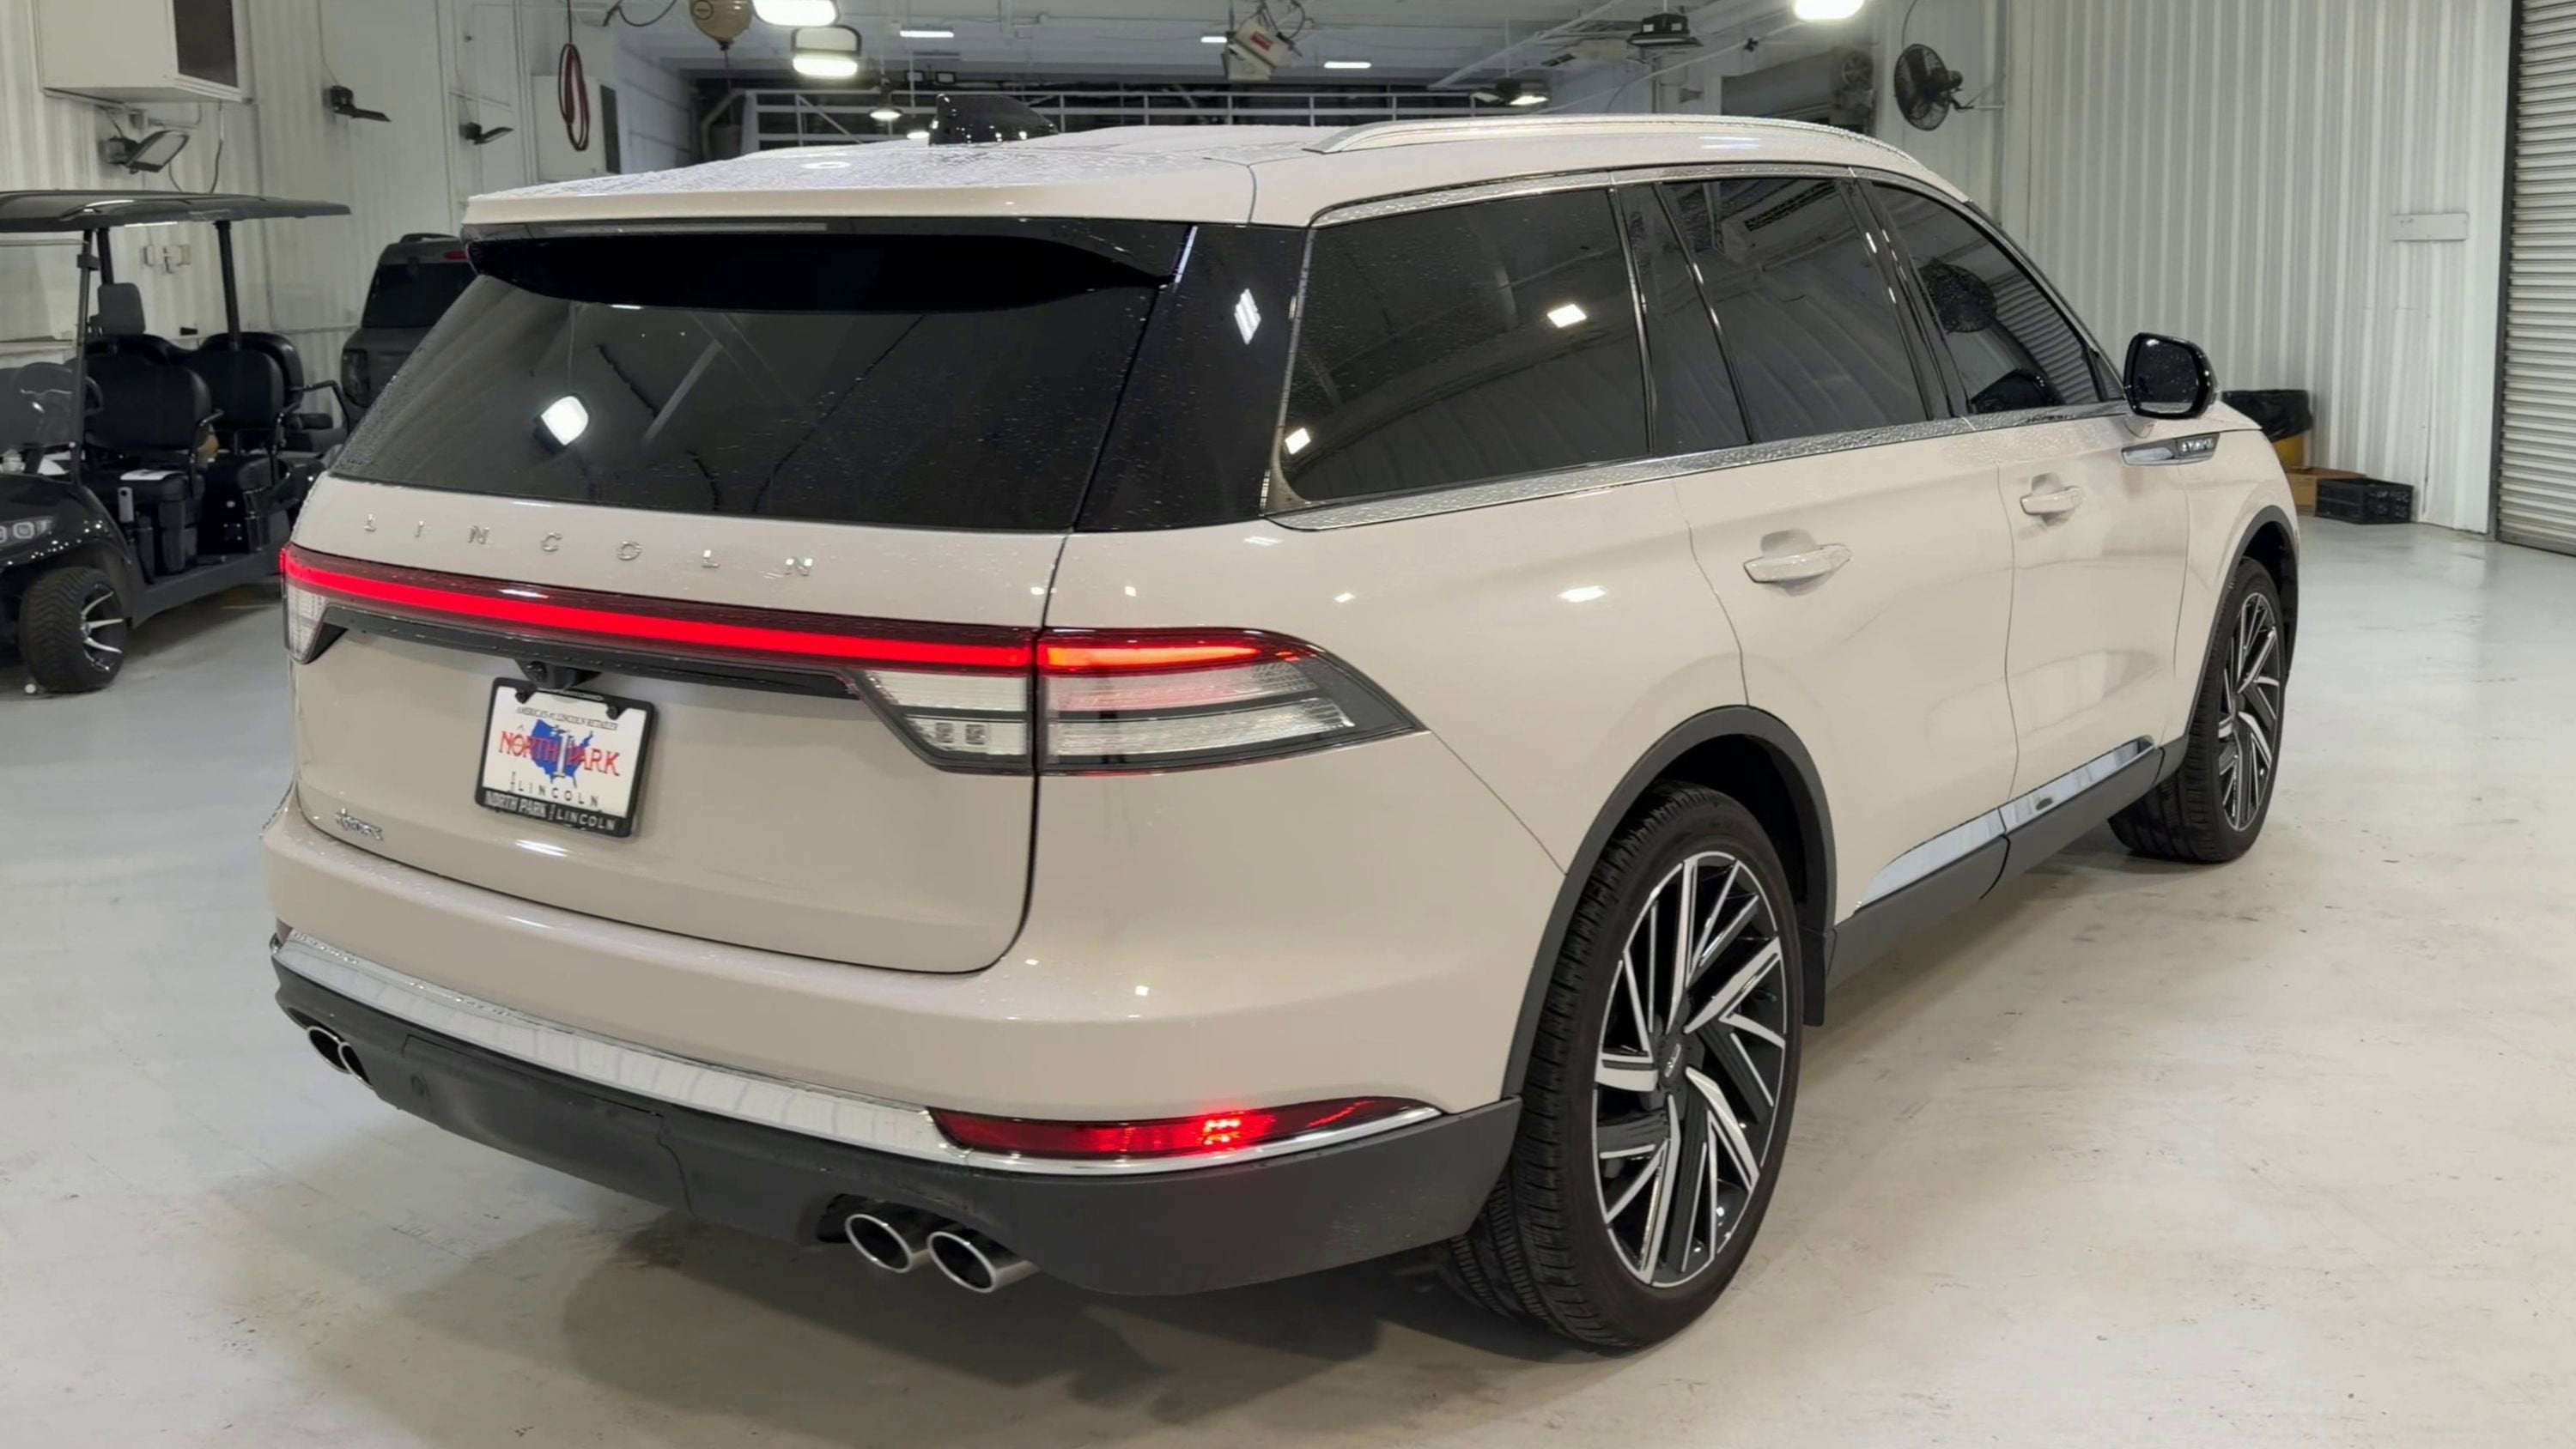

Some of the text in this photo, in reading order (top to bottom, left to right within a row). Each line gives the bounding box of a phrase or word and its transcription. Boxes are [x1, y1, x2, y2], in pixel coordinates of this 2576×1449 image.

[363, 514, 814, 577] LINCOLN
[499, 731, 620, 776] NORTH PARK
[484, 791, 617, 831] NORTH PARK LINCOLN
[518, 780, 598, 807] LINCOLN
